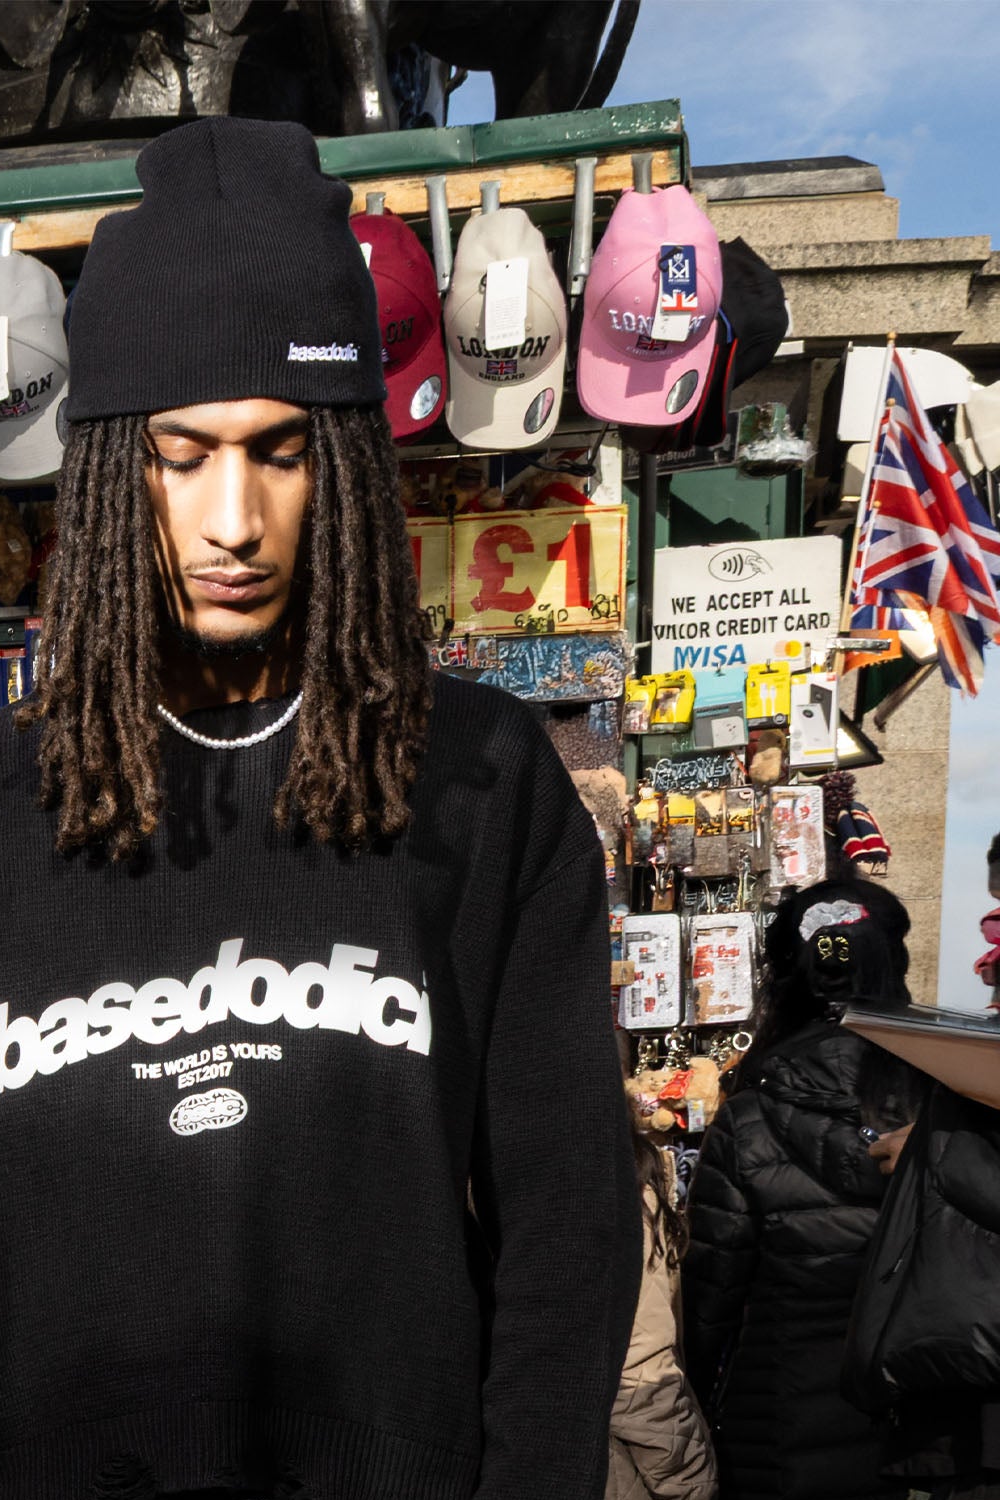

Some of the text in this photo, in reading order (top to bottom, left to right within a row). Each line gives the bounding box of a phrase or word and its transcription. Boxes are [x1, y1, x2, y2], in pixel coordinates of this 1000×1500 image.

[467, 524, 592, 613] £1
[671, 588, 811, 616] WE ACCEPT ALL
[716, 616, 779, 638] CREDIT
[784, 612, 831, 632] CARD
[131, 1042, 283, 1080] THE WORLD IS YOURS
